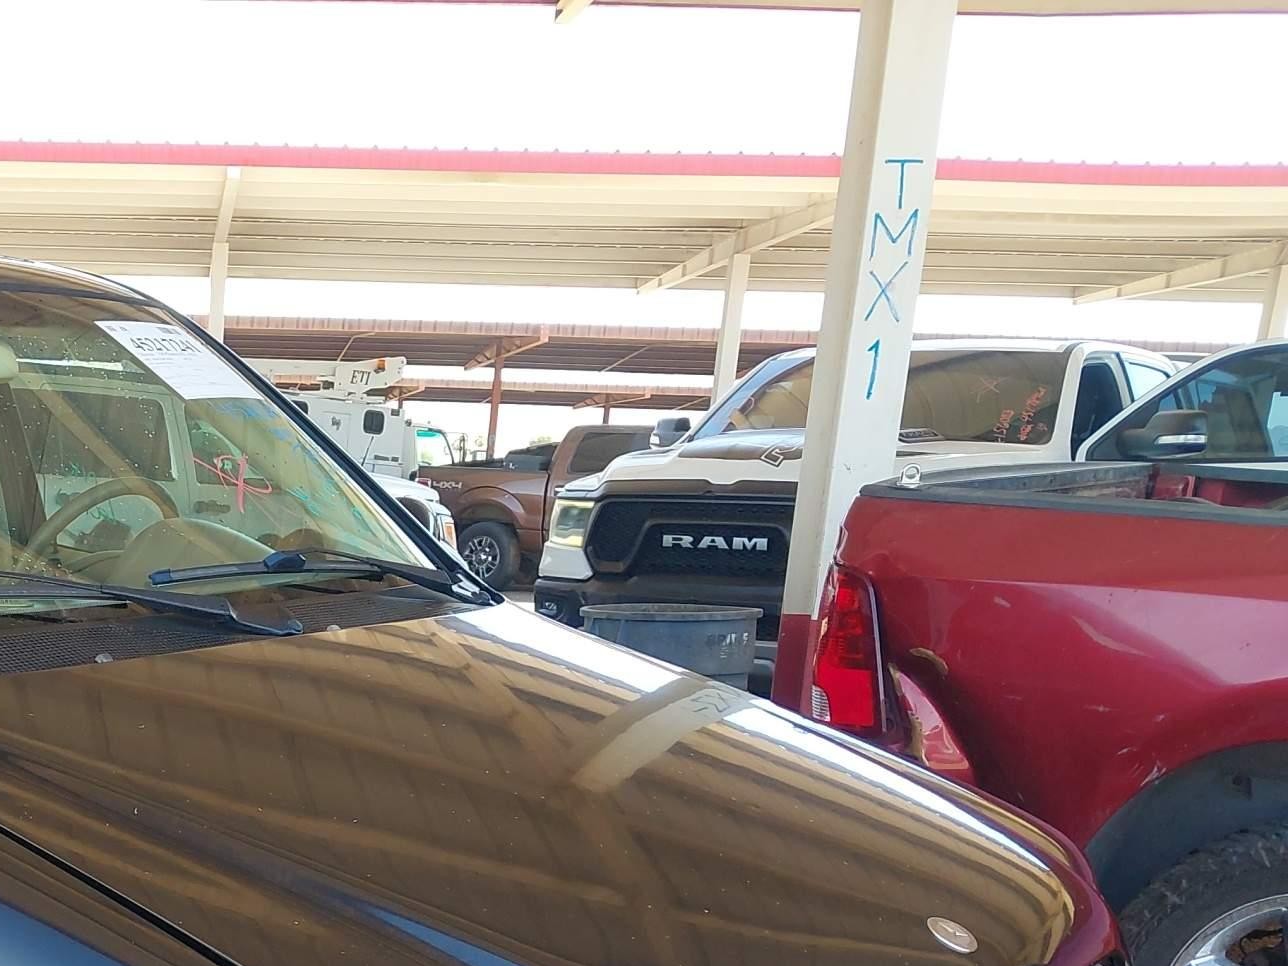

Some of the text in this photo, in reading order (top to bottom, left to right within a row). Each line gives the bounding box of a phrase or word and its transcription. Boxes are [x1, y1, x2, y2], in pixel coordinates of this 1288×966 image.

[130, 337, 202, 353] 45217241
[350, 369, 371, 386] ETI
[662, 534, 769, 551] RAM
